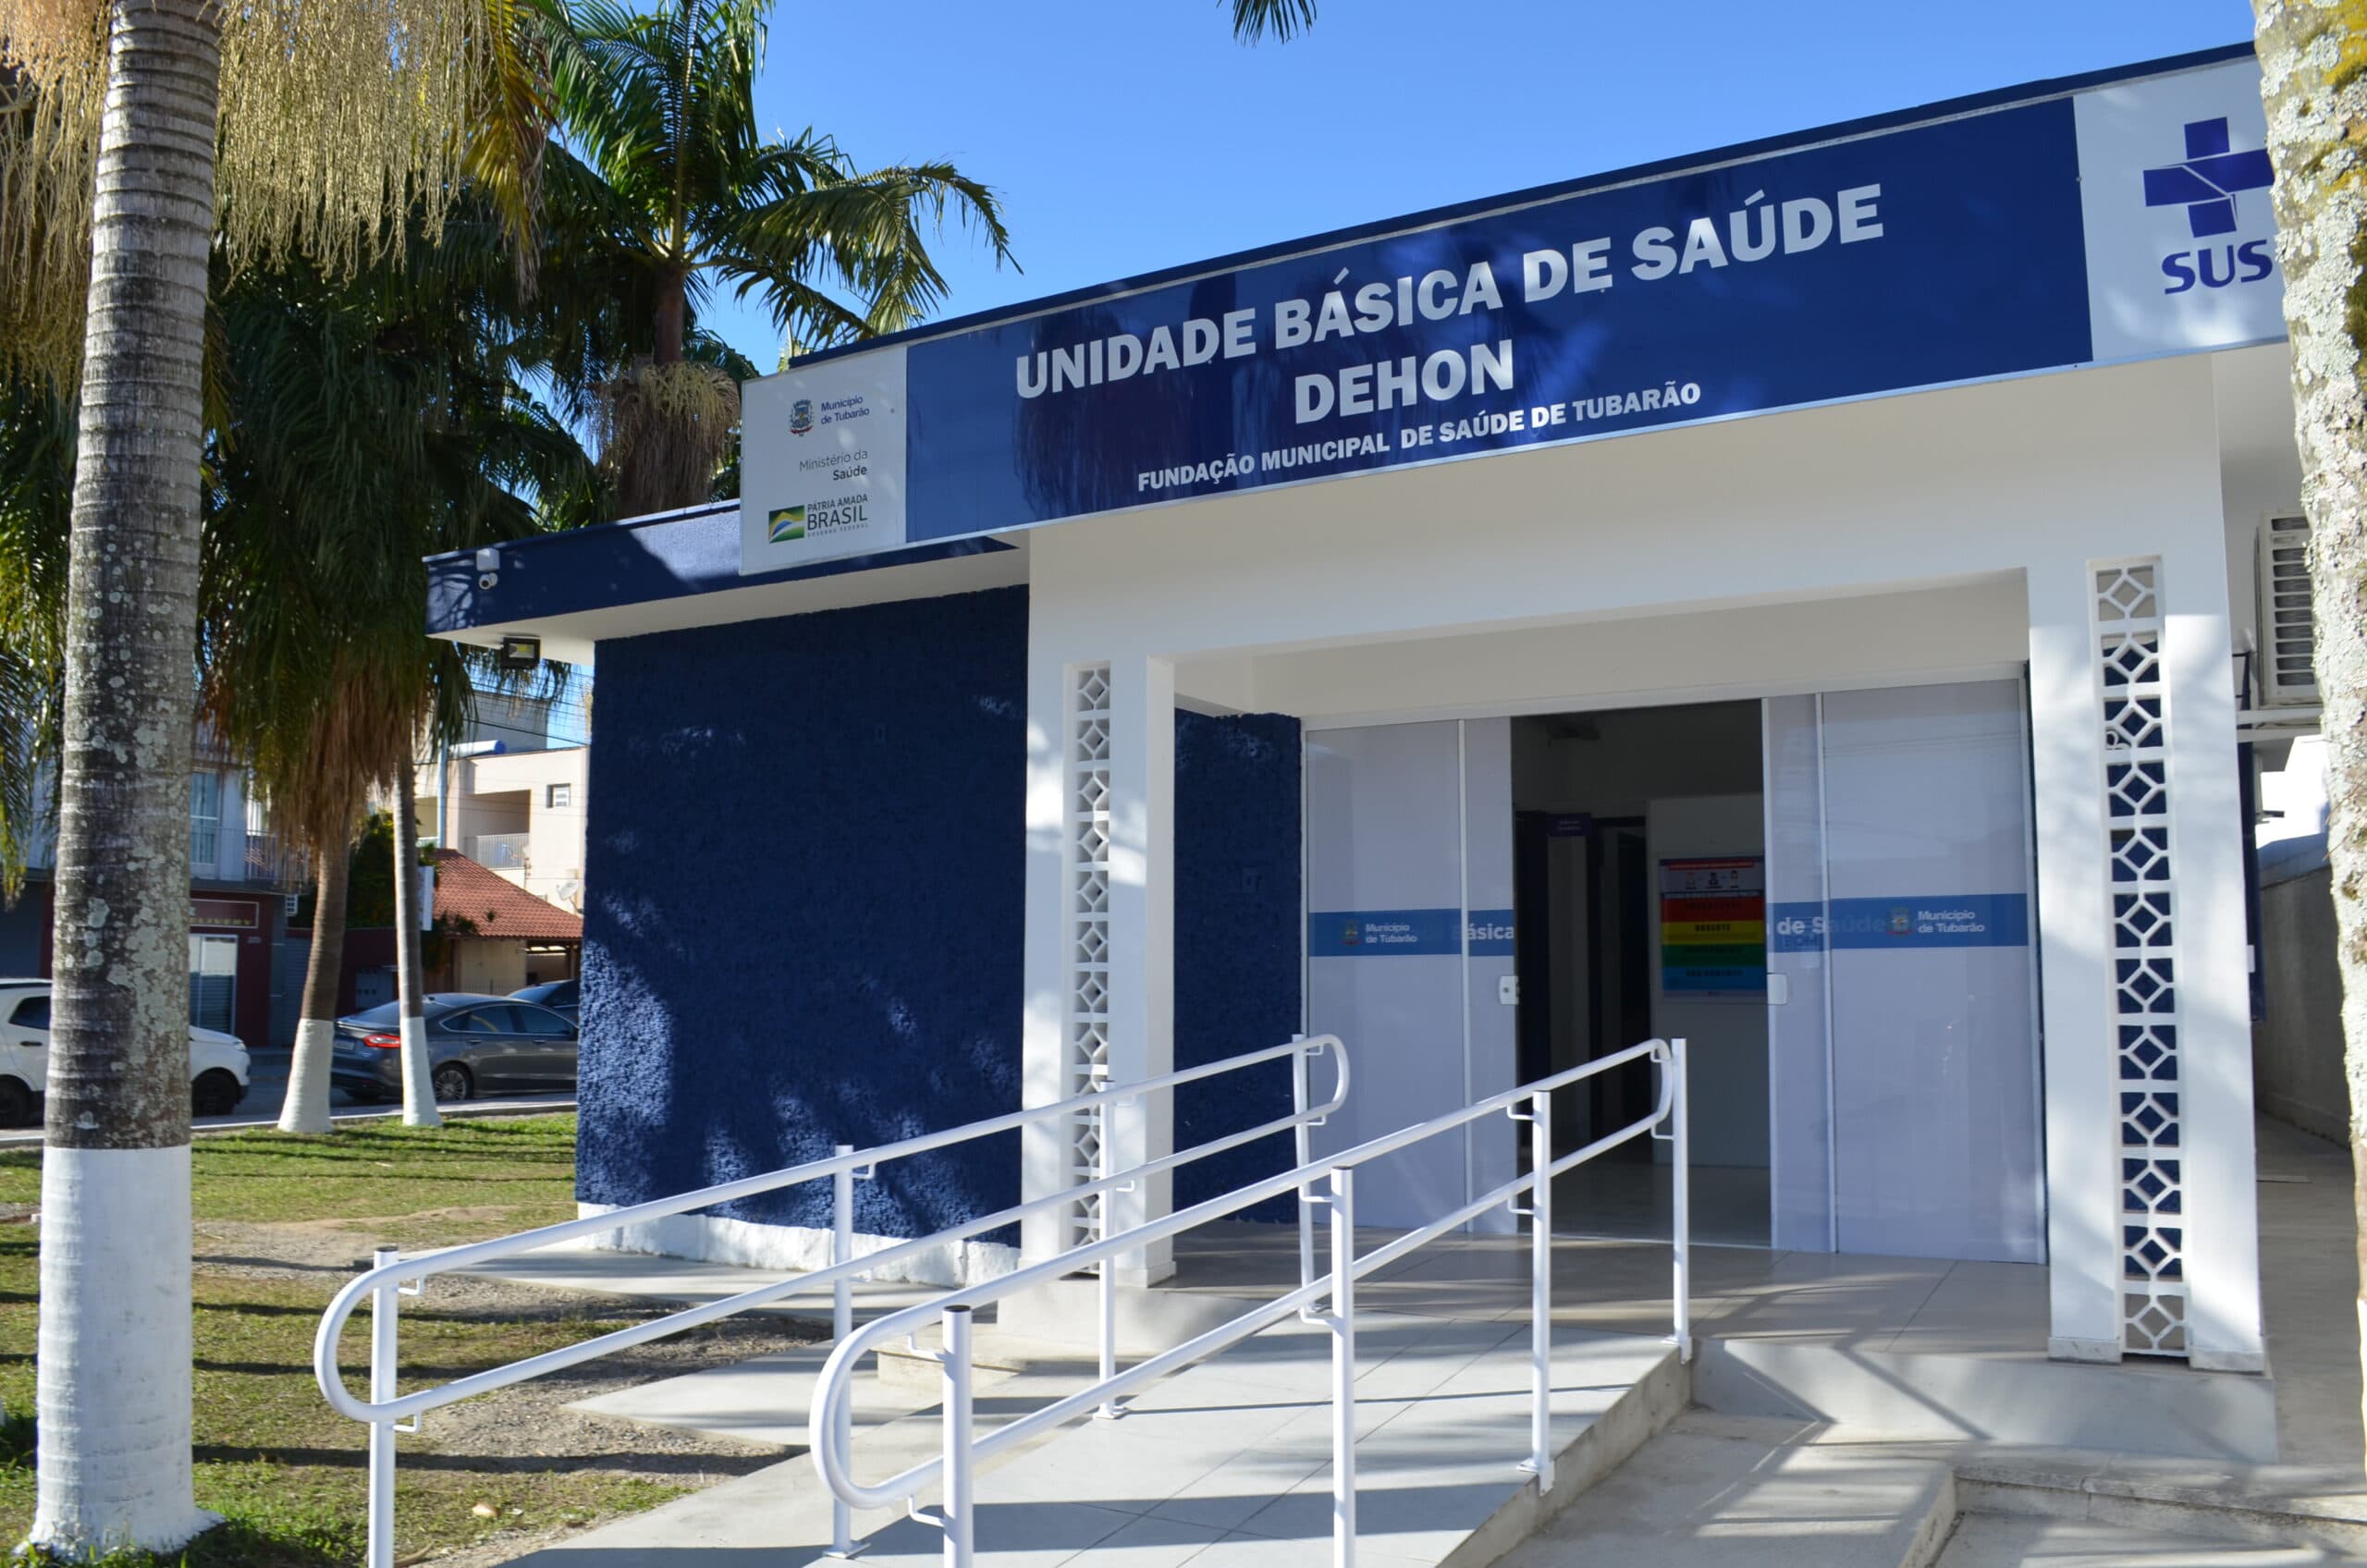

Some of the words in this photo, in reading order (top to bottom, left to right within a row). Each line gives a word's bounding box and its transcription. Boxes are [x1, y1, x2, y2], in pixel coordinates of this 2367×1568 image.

[2161, 239, 2274, 295] SUS
[1016, 307, 1257, 399] UNIDADE
[1274, 261, 1503, 349] BÁSICA
[1523, 237, 1613, 303] DE
[1631, 183, 1884, 281] SAÚDE
[1294, 338, 1514, 425] DEHON
[821, 414, 832, 425] de
[834, 406, 870, 423] Tubarão
[1138, 453, 1256, 492] FUNDAÇÃO
[1261, 432, 1391, 472] MUNICIPAL
[1400, 424, 1433, 449] DE
[1439, 410, 1525, 443] SAÚDE
[1530, 402, 1566, 429] DE
[1572, 380, 1701, 422] TUBARÃO
[853, 448, 868, 461] da
[832, 465, 867, 481] Saúde
[838, 493, 868, 508] AMADA
[807, 504, 868, 531] BRASIL
[1776, 917, 1805, 935] de
[1918, 924, 1933, 933] de
[1937, 923, 1985, 934] Tubarão
[1366, 935, 1378, 943] de
